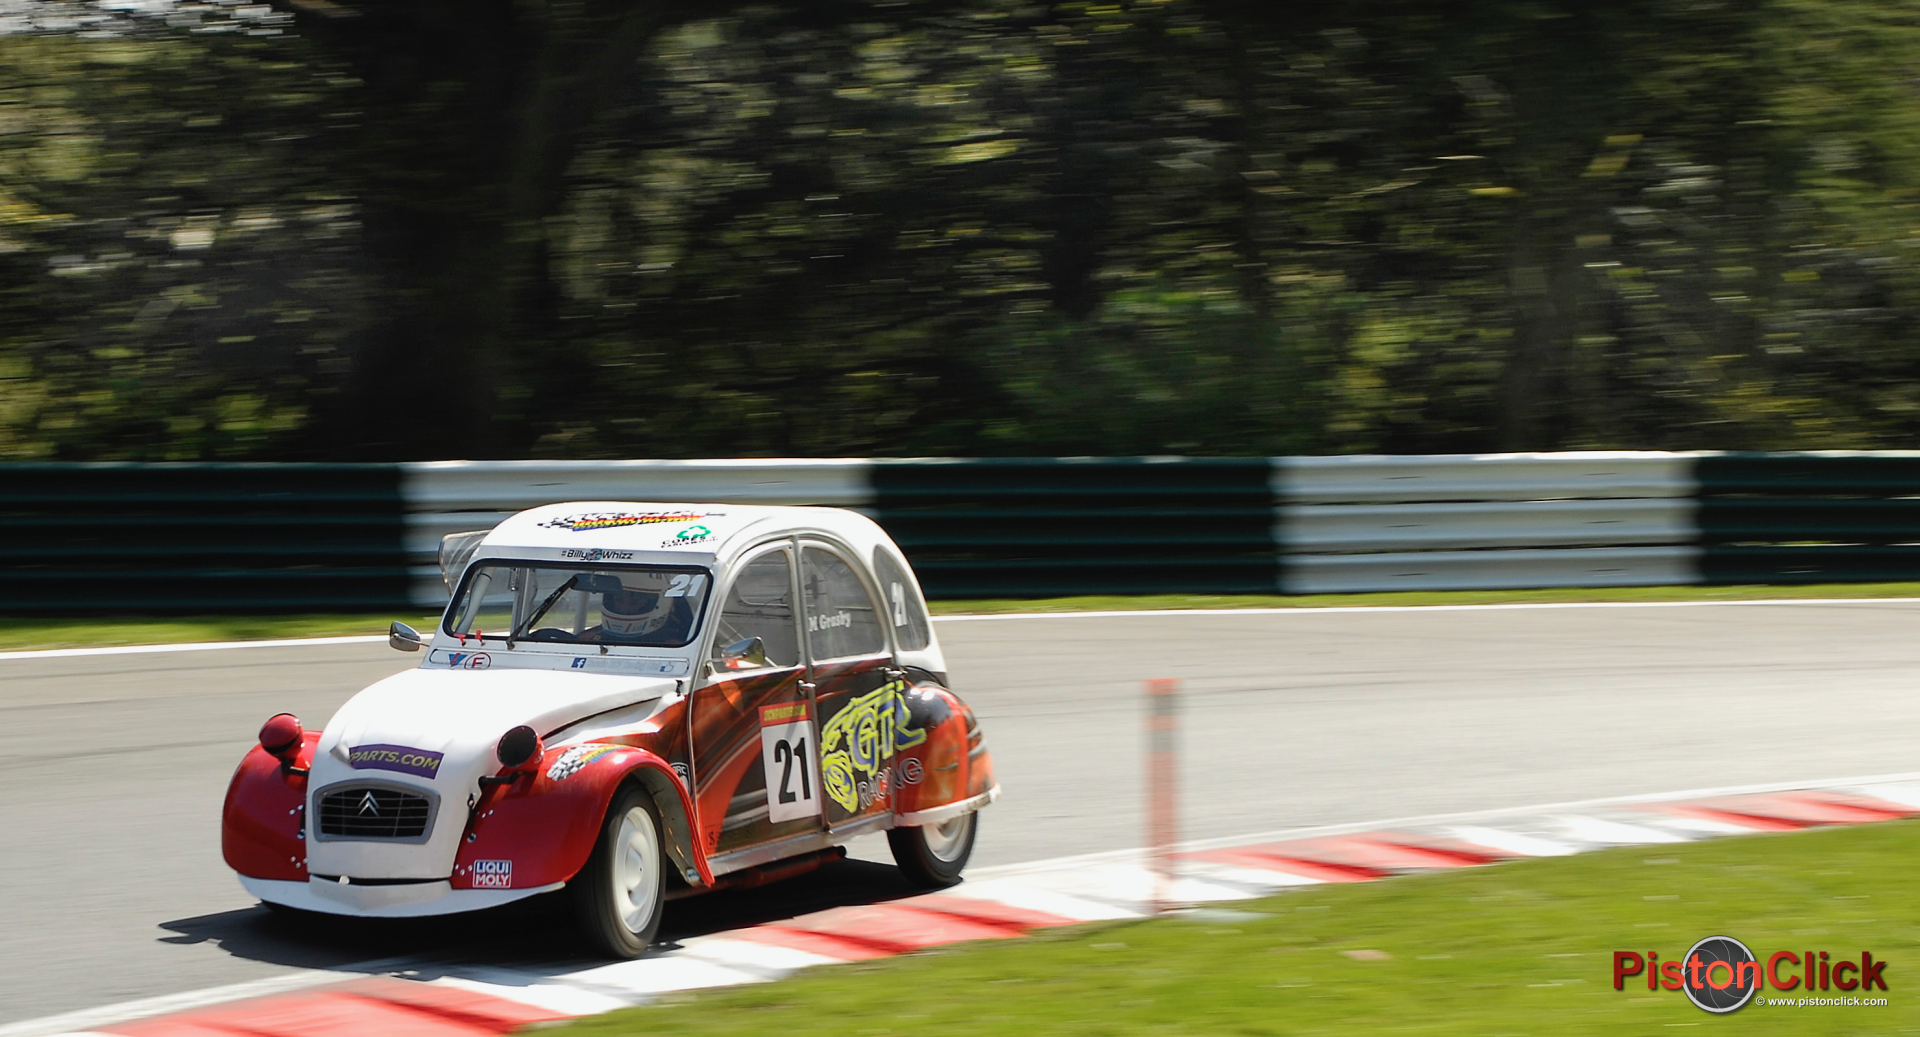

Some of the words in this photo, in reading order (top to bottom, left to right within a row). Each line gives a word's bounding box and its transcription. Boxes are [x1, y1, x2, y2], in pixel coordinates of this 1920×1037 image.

[602, 551, 633, 560] Whizz
[663, 574, 705, 598] 21
[890, 582, 907, 627] 21
[350, 750, 441, 770] PARTS.COM
[774, 737, 812, 805] 21
[475, 861, 511, 874] LIQUI
[475, 873, 511, 887] MOLY
